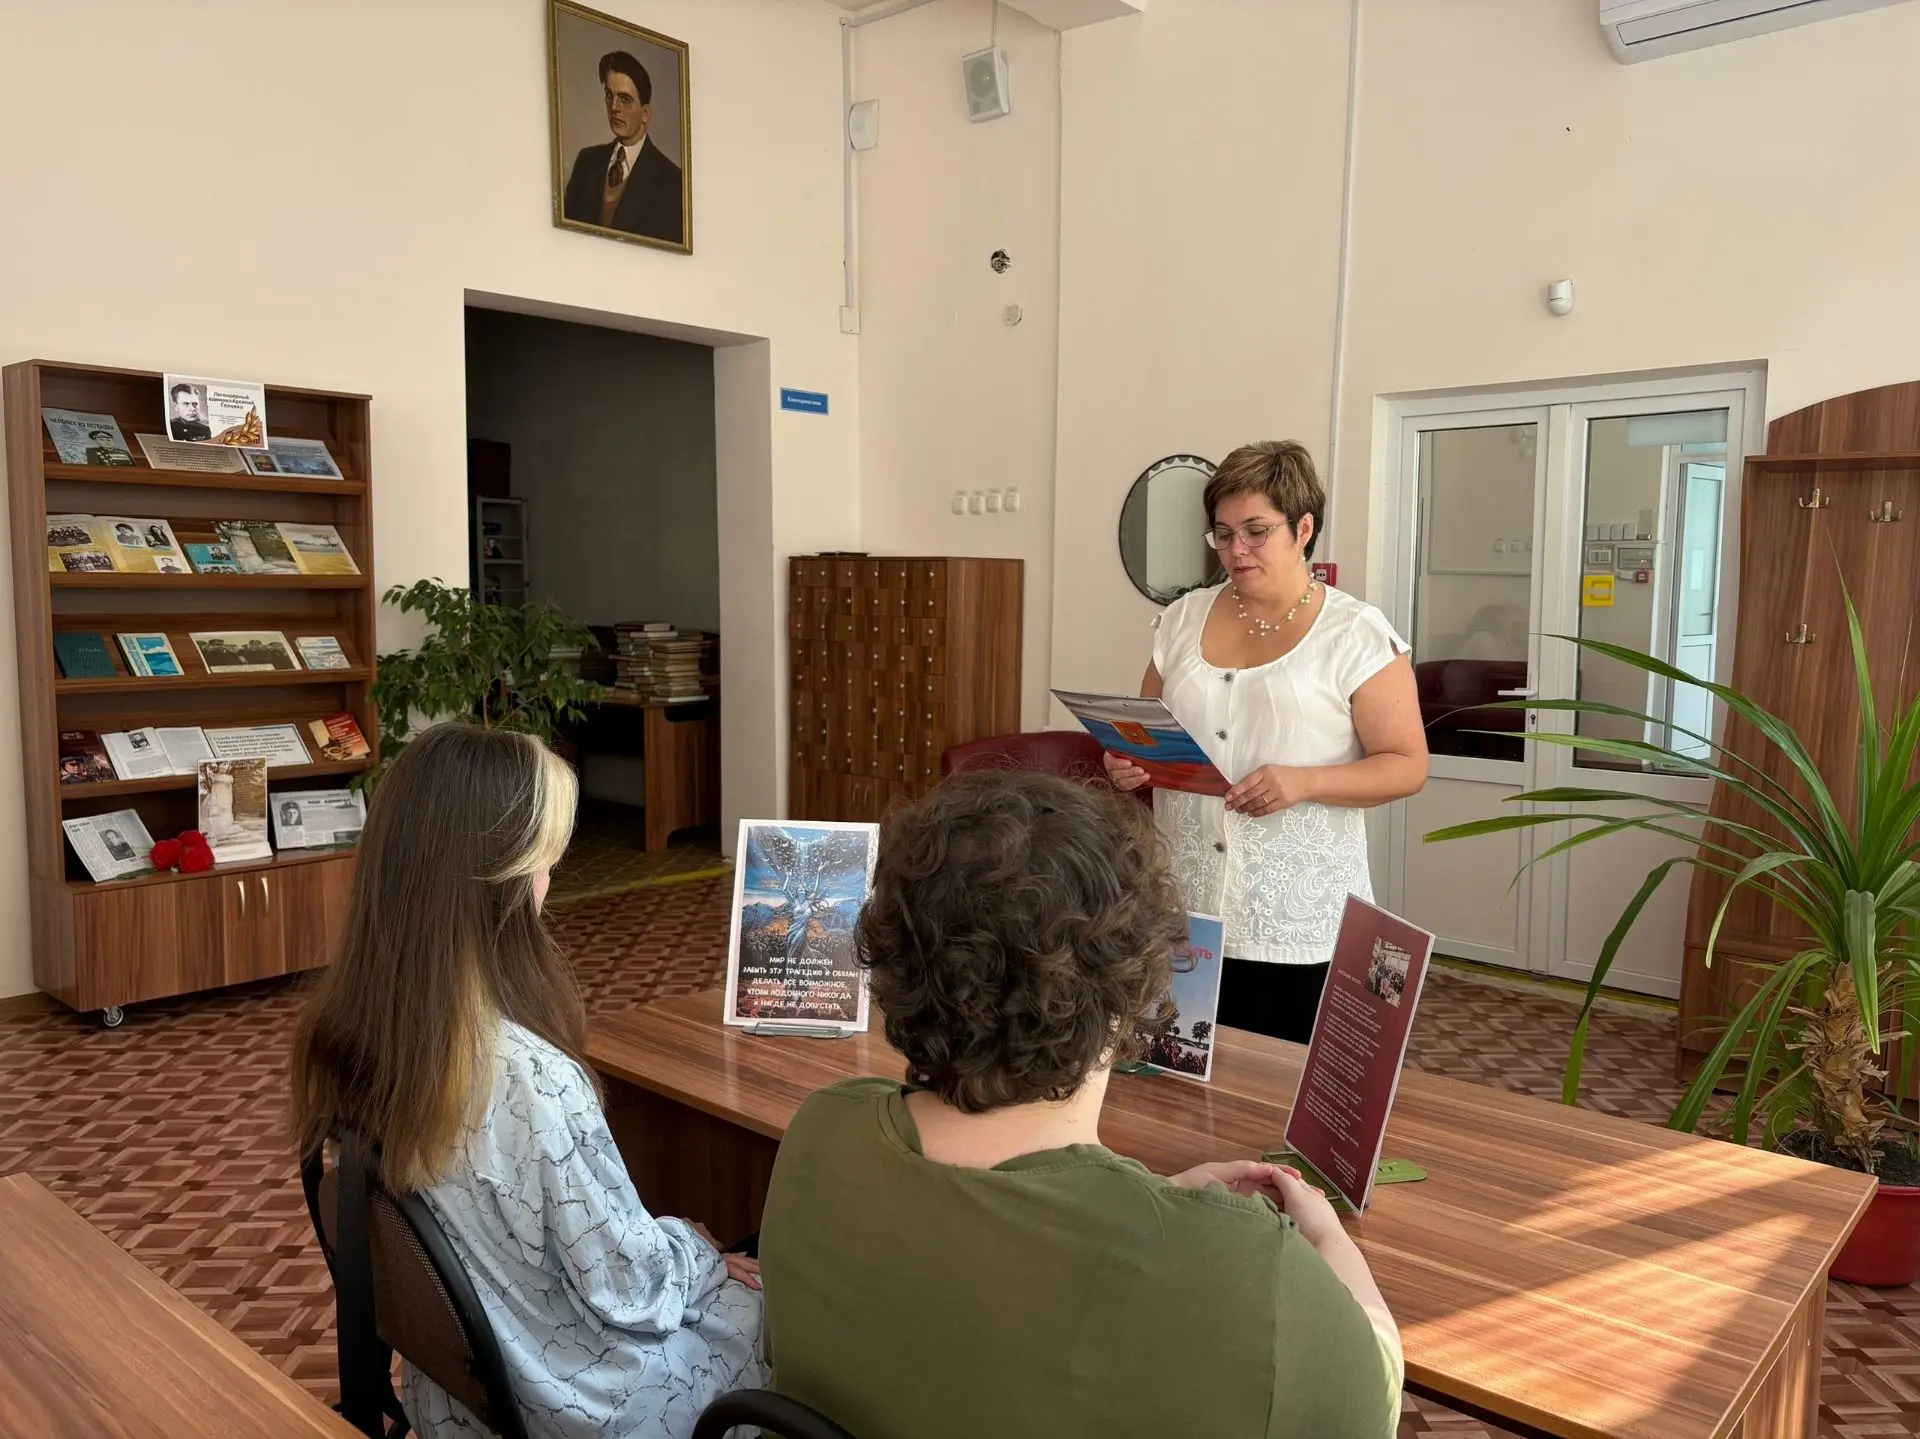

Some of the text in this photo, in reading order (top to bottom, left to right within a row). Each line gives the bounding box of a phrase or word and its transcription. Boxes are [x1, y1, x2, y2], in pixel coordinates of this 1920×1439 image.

[769, 956, 833, 966] МИР НЕ ДОЛЖЕН
[743, 966, 767, 974] ЗАБЫТЬ
[770, 967, 783, 975] ЭТУ
[786, 967, 823, 977] ТРАГЕДИЮ
[832, 970, 859, 978] ОБЯЗАН
[751, 978, 781, 986] ДЕЛАТЬ
[746, 988, 852, 1000] ЧТОБЫ ПОДОБНОГО НИКОГДА
[761, 1000, 785, 1008] НИГДЕ
